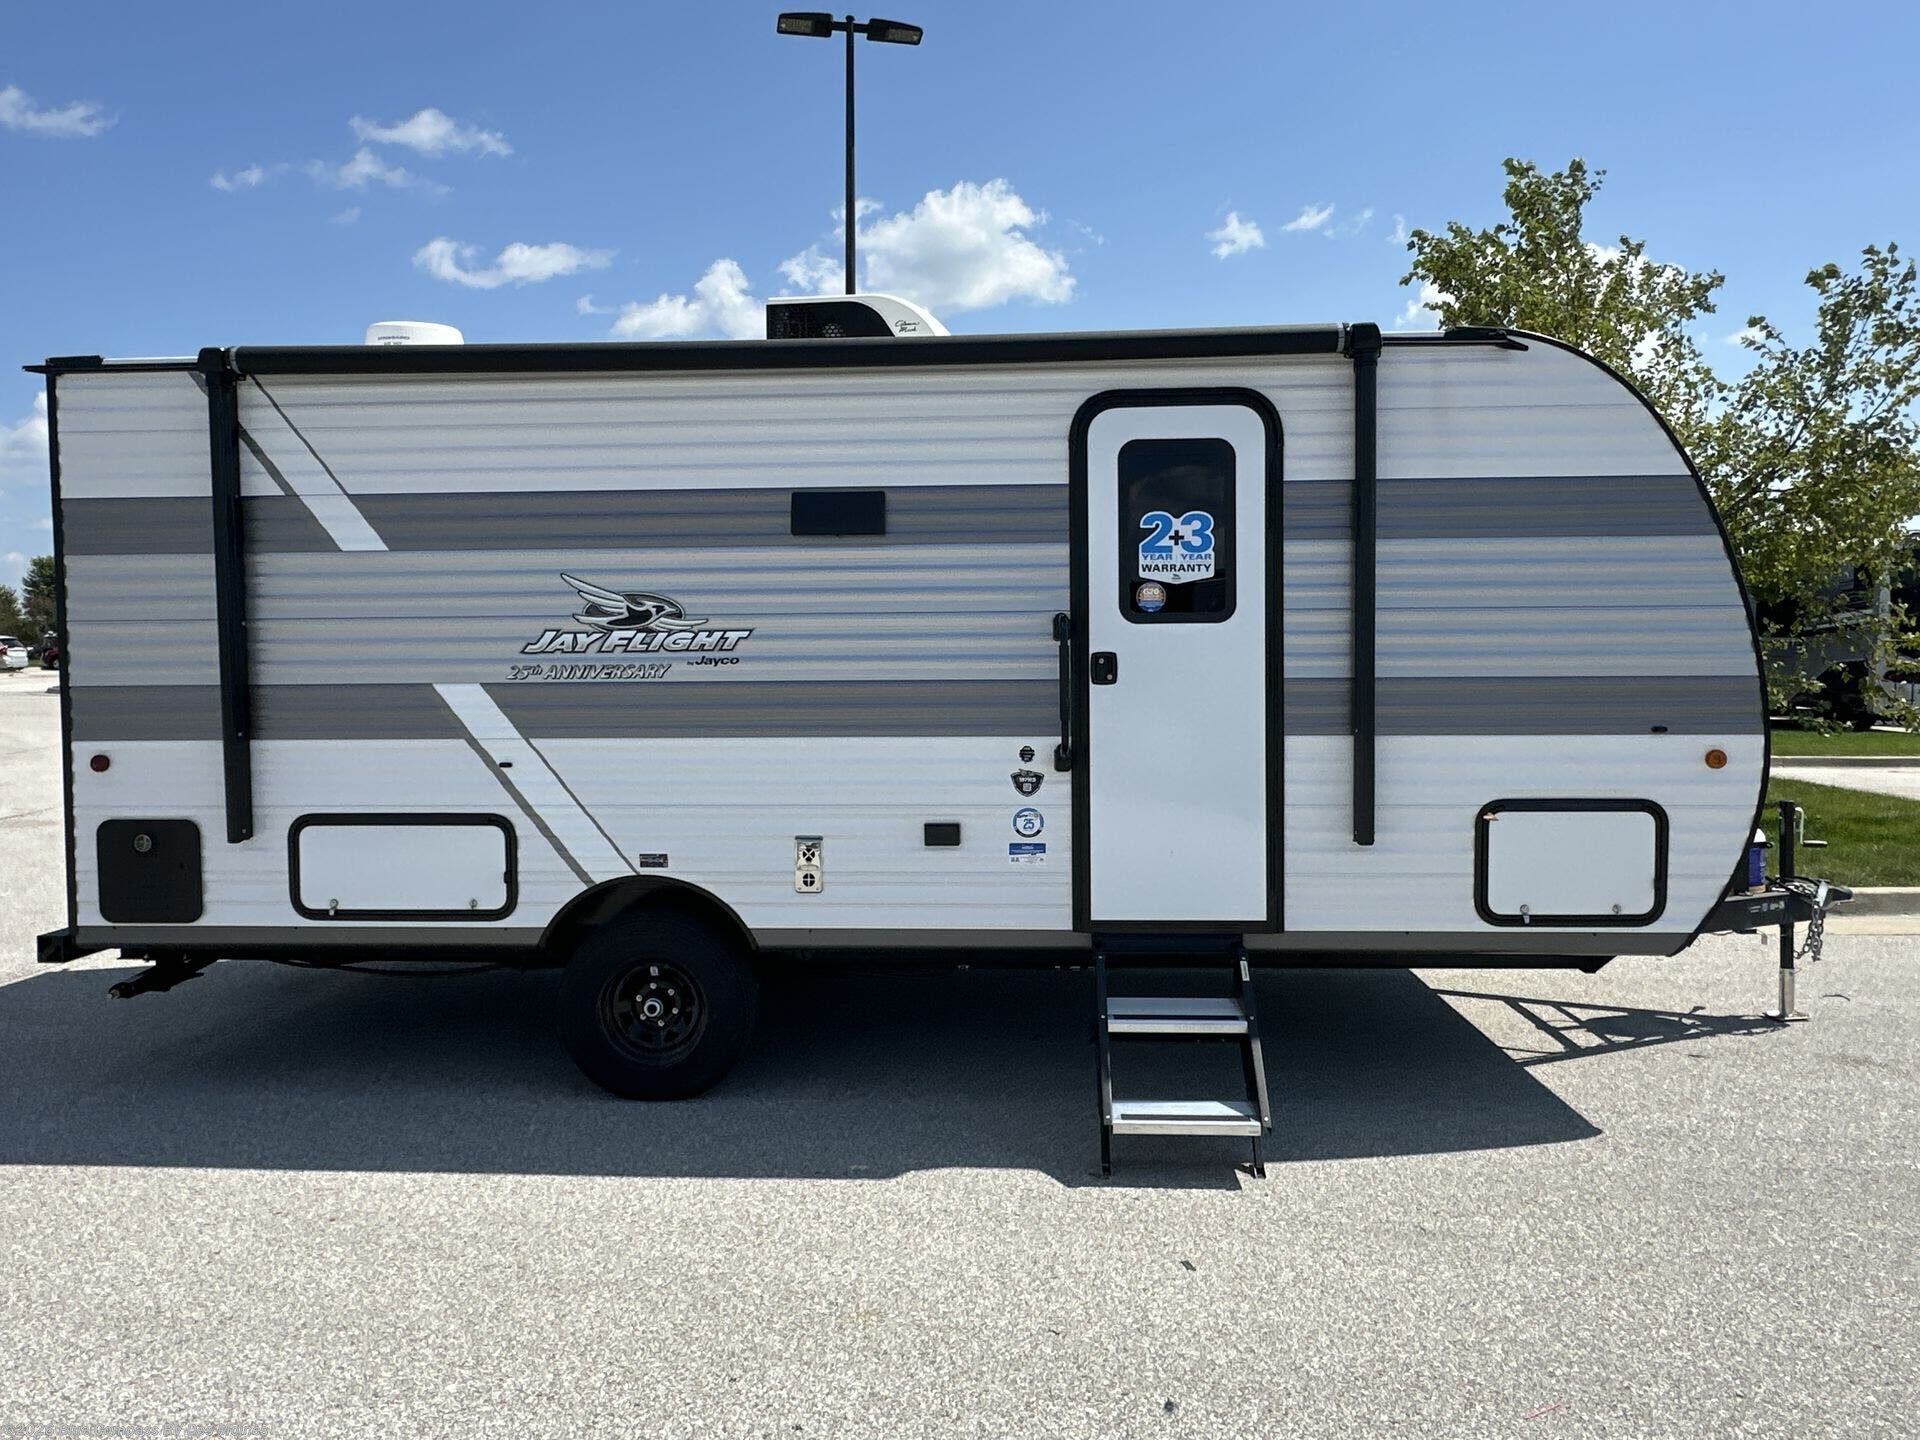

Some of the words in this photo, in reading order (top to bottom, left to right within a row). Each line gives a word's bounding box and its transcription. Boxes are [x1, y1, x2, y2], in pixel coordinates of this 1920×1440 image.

[1141, 564, 1212, 572] WARRANTY
[520, 629, 608, 654] JAY
[597, 628, 756, 653] FLIGHT
[695, 655, 740, 667] Jayco
[506, 664, 543, 680] 25th
[544, 664, 672, 680] ANNIVERSARY
